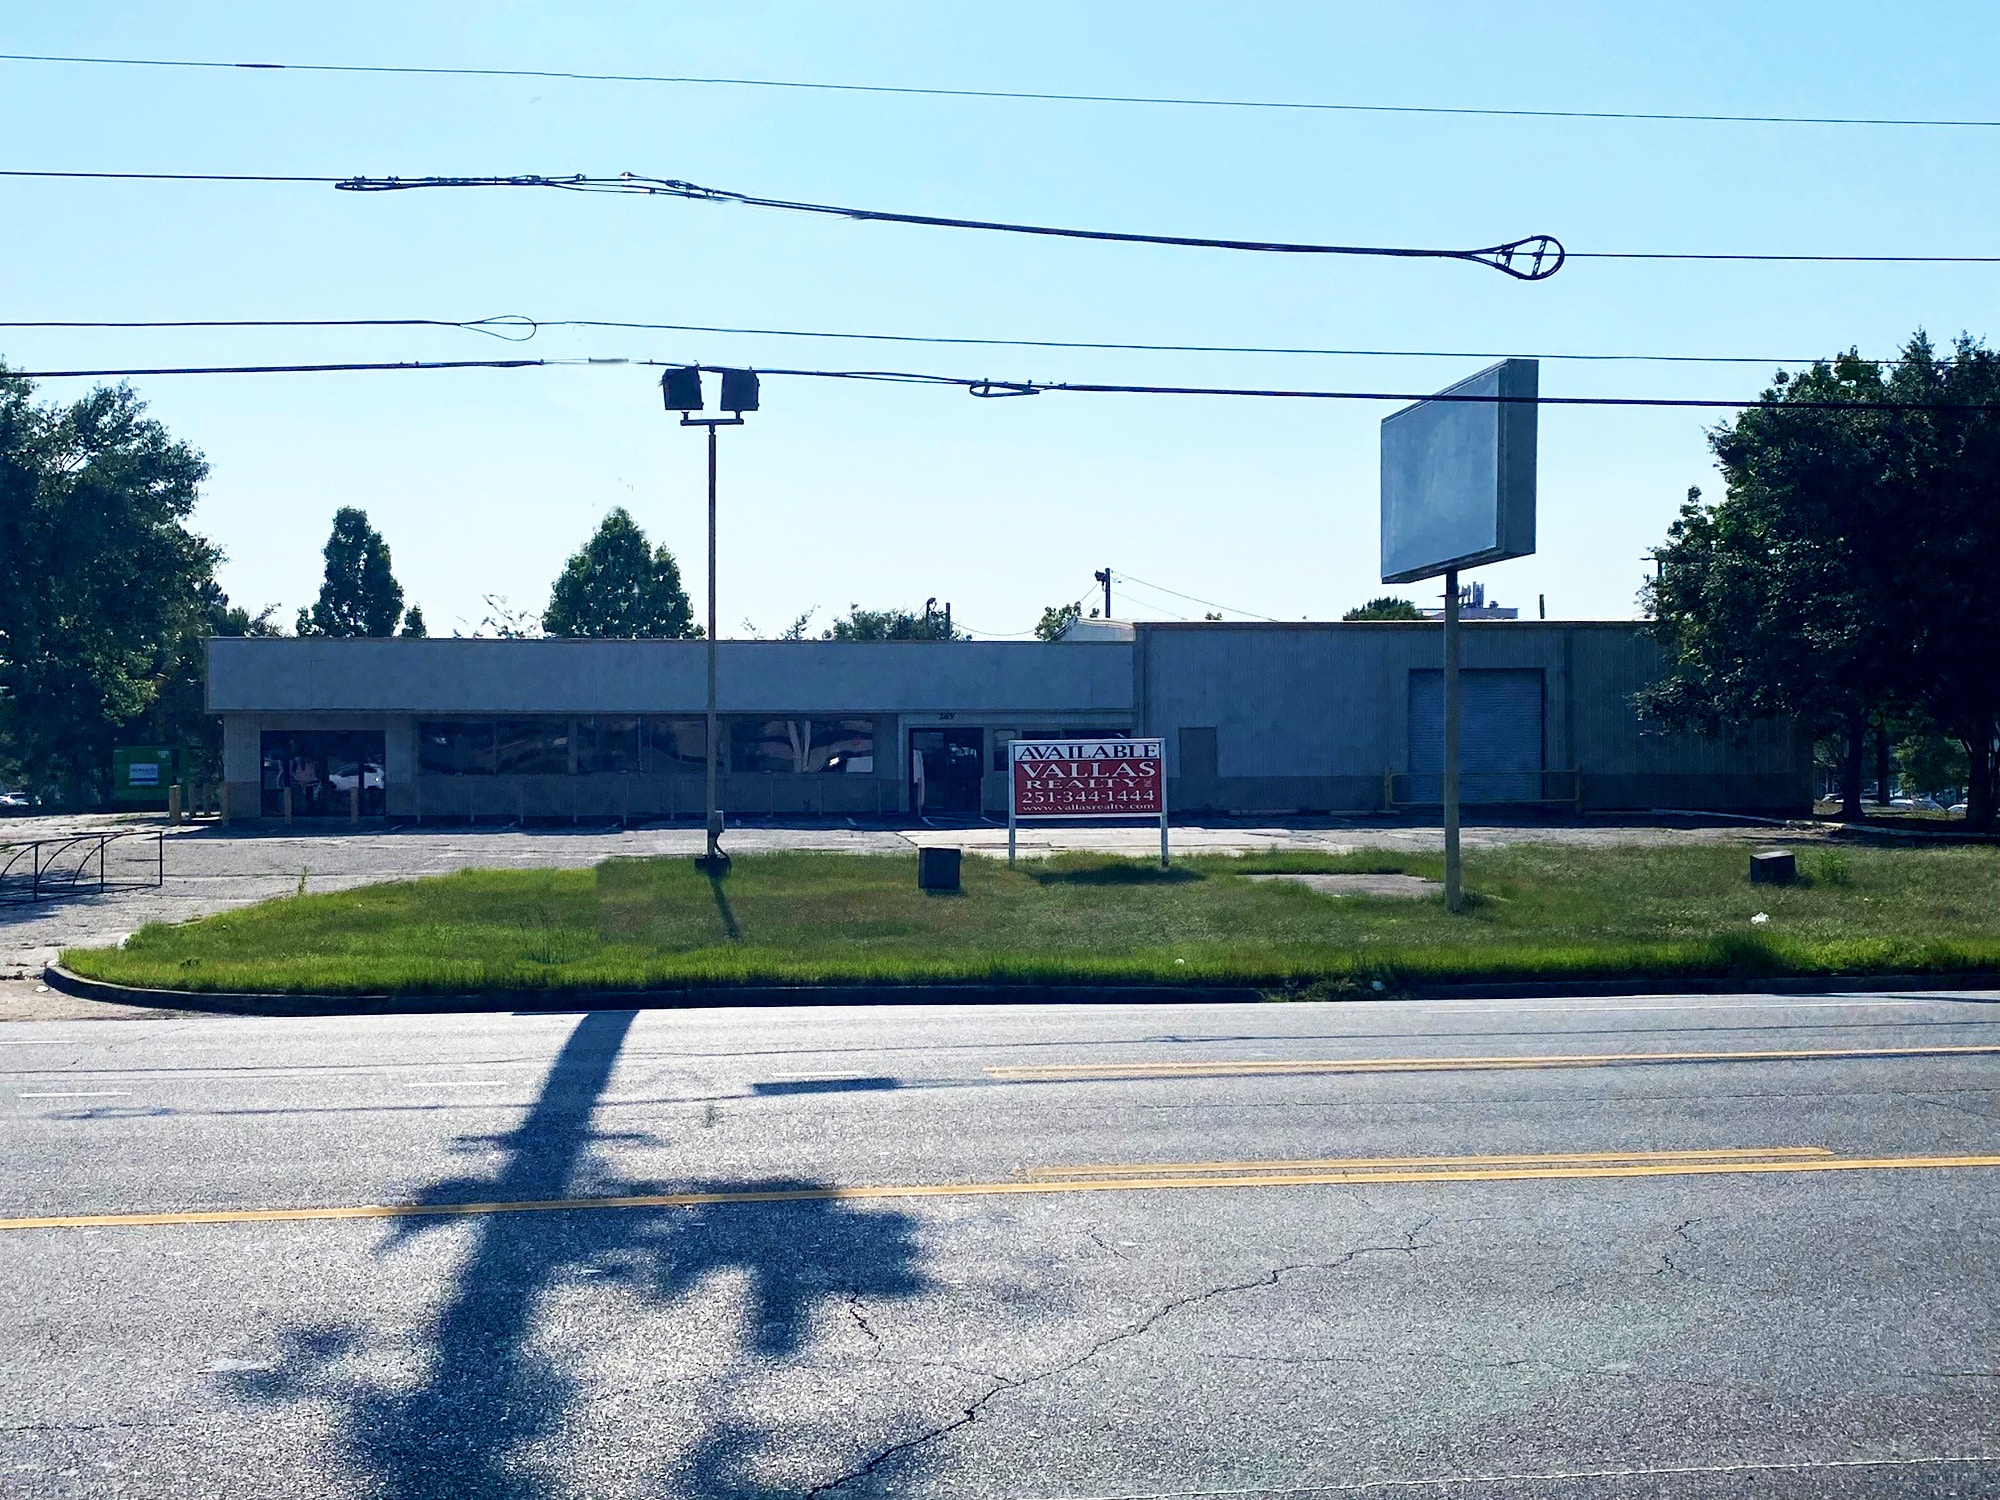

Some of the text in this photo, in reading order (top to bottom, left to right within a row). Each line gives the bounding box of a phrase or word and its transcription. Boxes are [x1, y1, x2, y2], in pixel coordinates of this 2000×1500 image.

[1019, 744, 1158, 759] AVAILABLE
[1021, 762, 1156, 778] VALLAS
[1026, 778, 1140, 789] REALTY
[1022, 790, 1155, 803] 251-344-1444
